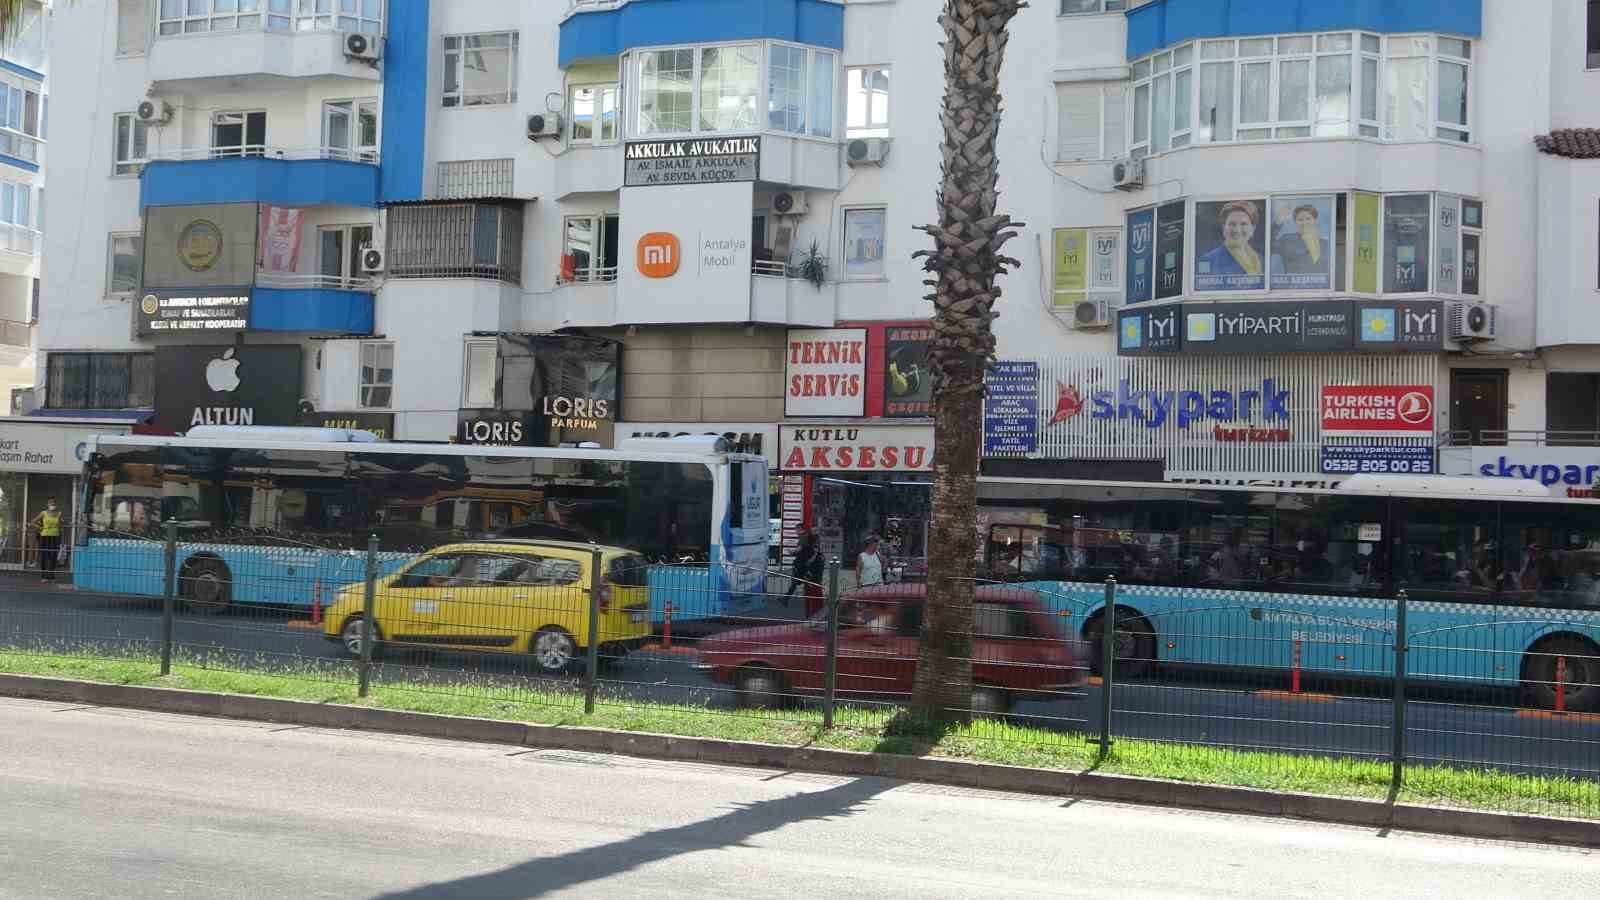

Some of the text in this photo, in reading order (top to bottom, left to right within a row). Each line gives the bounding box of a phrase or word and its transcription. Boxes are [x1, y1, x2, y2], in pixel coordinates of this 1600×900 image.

[626, 138, 758, 159] AKKULAK AVUKATLIK
[655, 158, 691, 170] İSMAİL
[695, 157, 746, 168] AKKULAK
[663, 172, 696, 181] SEVDA
[701, 169, 736, 181] KÜÇÜK
[704, 238, 746, 252] Antalya
[704, 256, 735, 267] Mobil
[1149, 312, 1175, 338] İYİ
[1404, 308, 1437, 333] İYİ
[543, 396, 608, 418] LORIS
[1092, 378, 1291, 428] skypark
[1324, 395, 1396, 408] TURKISH
[191, 407, 254, 425] ALTUN
[1324, 408, 1396, 420] AIRLINES
[464, 420, 523, 442] LORIS
[551, 418, 597, 430] PARFUM
[793, 429, 859, 440] KUTLU
[24, 451, 53, 463] Rahat
[784, 446, 934, 468] AKSESU
[1326, 446, 1427, 454] www.skyparktur.com
[1323, 459, 1431, 473] 0532 205 00 25
